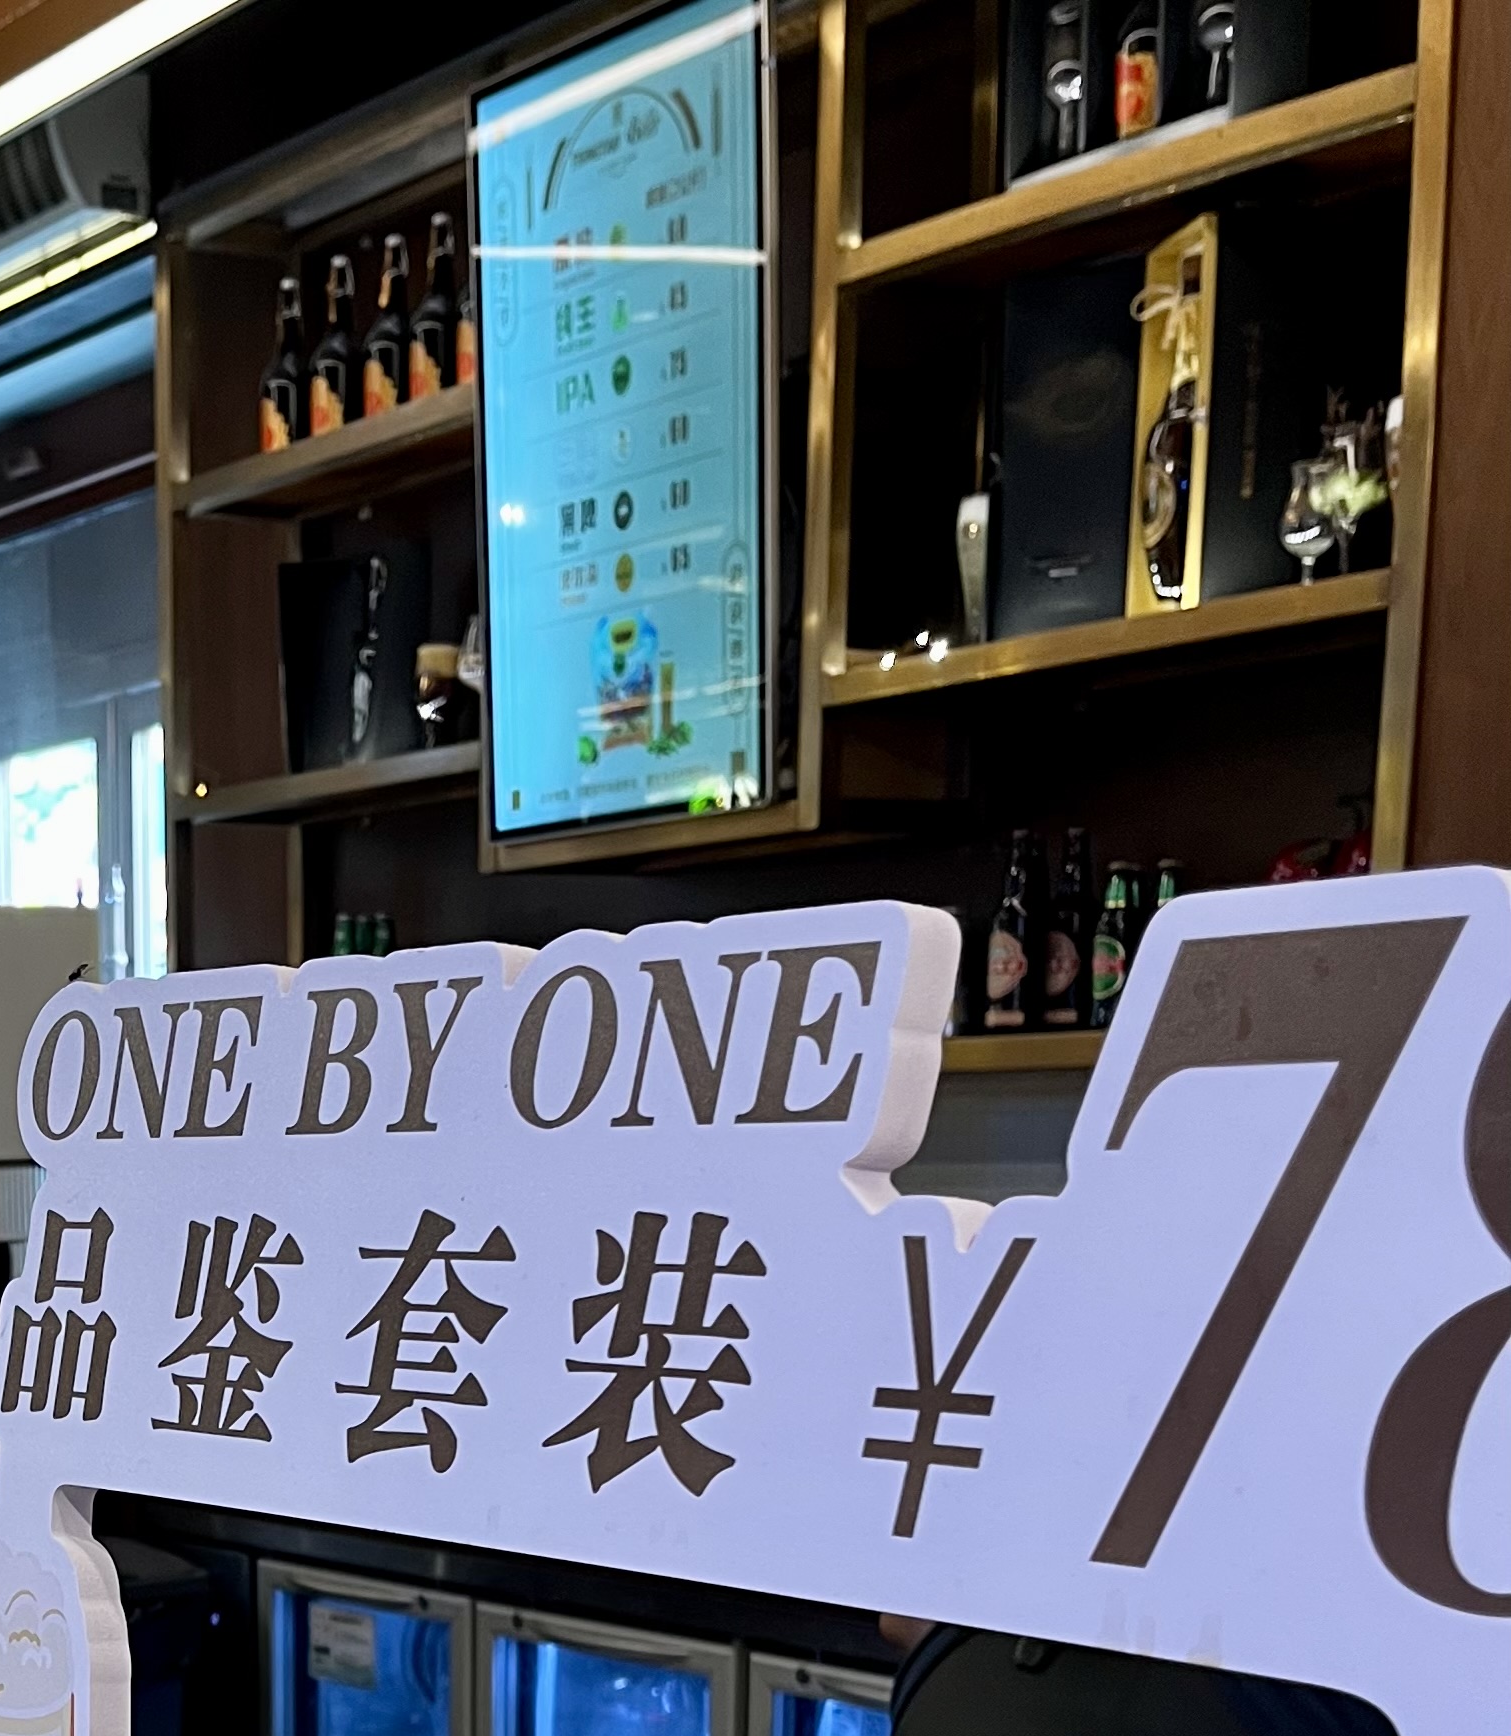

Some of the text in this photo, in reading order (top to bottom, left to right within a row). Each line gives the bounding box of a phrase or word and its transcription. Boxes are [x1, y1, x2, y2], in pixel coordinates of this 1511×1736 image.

[31, 940, 882, 1142] ONE BY ONE
[0, 1206, 768, 1498] 品鉴套装
